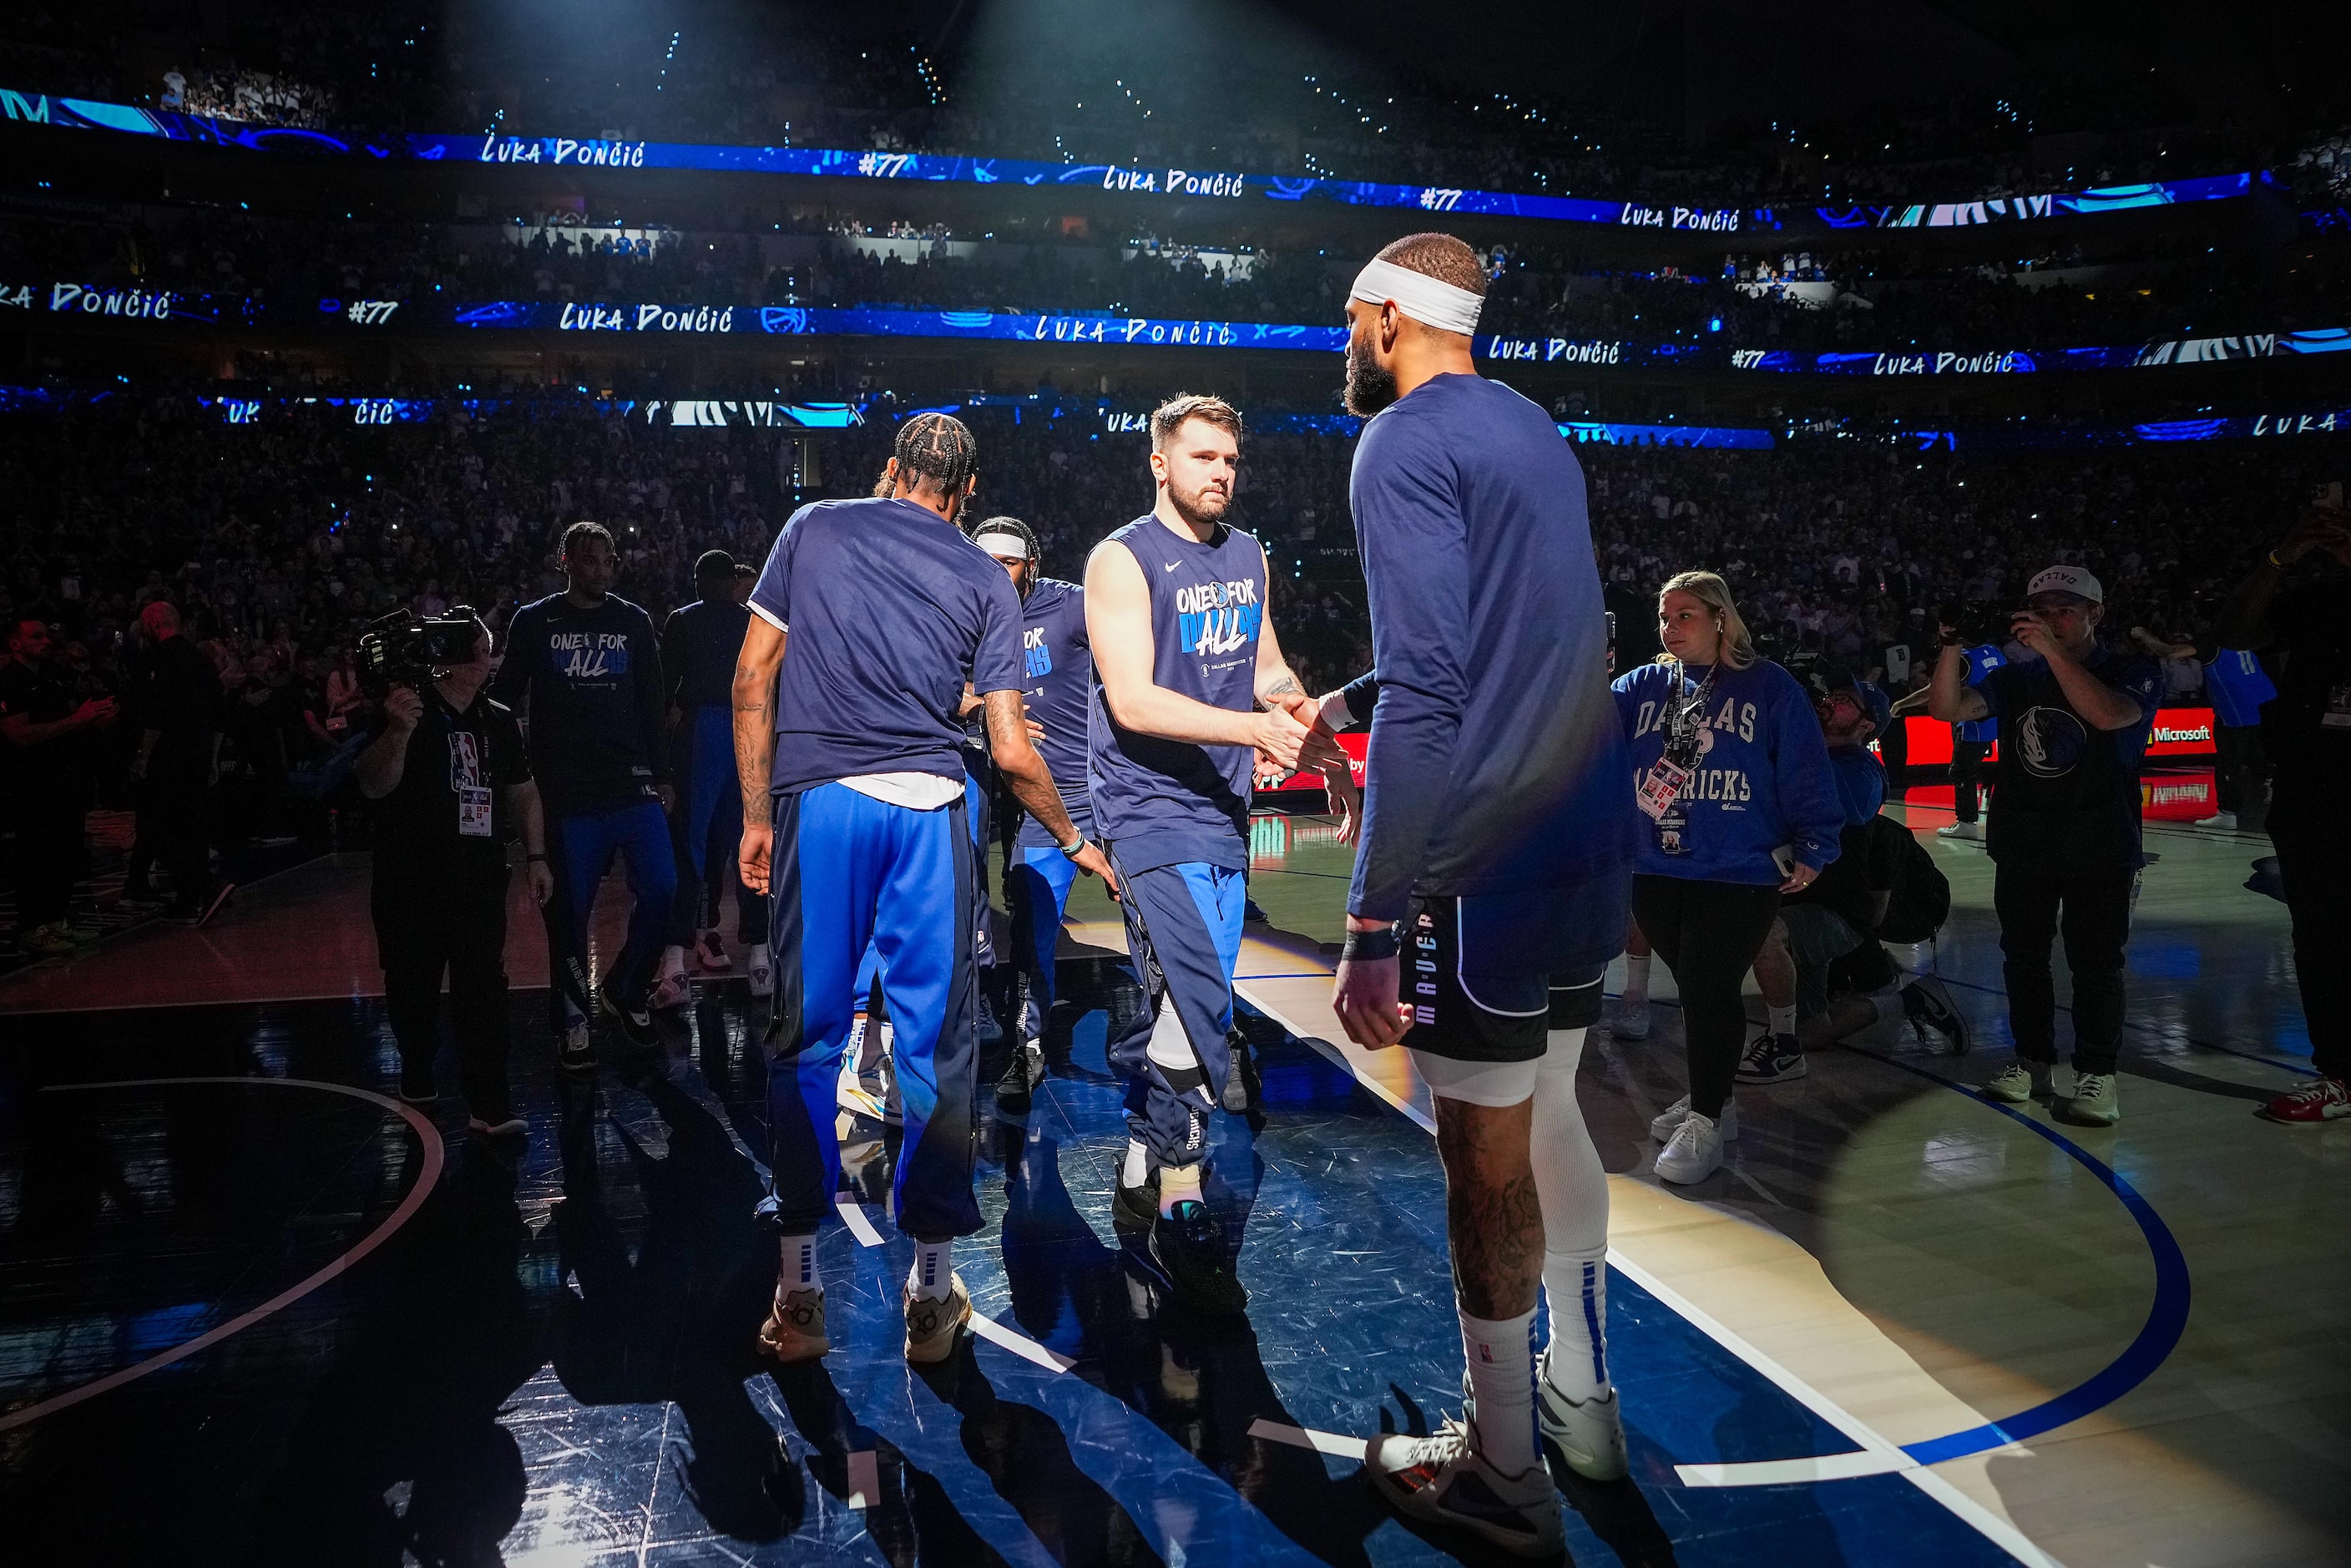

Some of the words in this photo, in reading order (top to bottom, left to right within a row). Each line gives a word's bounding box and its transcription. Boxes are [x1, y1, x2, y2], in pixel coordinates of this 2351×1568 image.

[858, 152, 909, 178] #77
[1420, 187, 1463, 211] #77
[348, 301, 398, 325] #77
[1732, 349, 1766, 369] #77
[1176, 583, 1213, 615] ONE
[1226, 578, 1258, 609] FOR
[550, 633, 584, 651] ONE
[597, 633, 628, 653] FOR
[1023, 626, 1045, 652] OR
[1195, 609, 1248, 656] ALL
[564, 649, 608, 677] ALL
[2154, 725, 2211, 741] Microsoft
